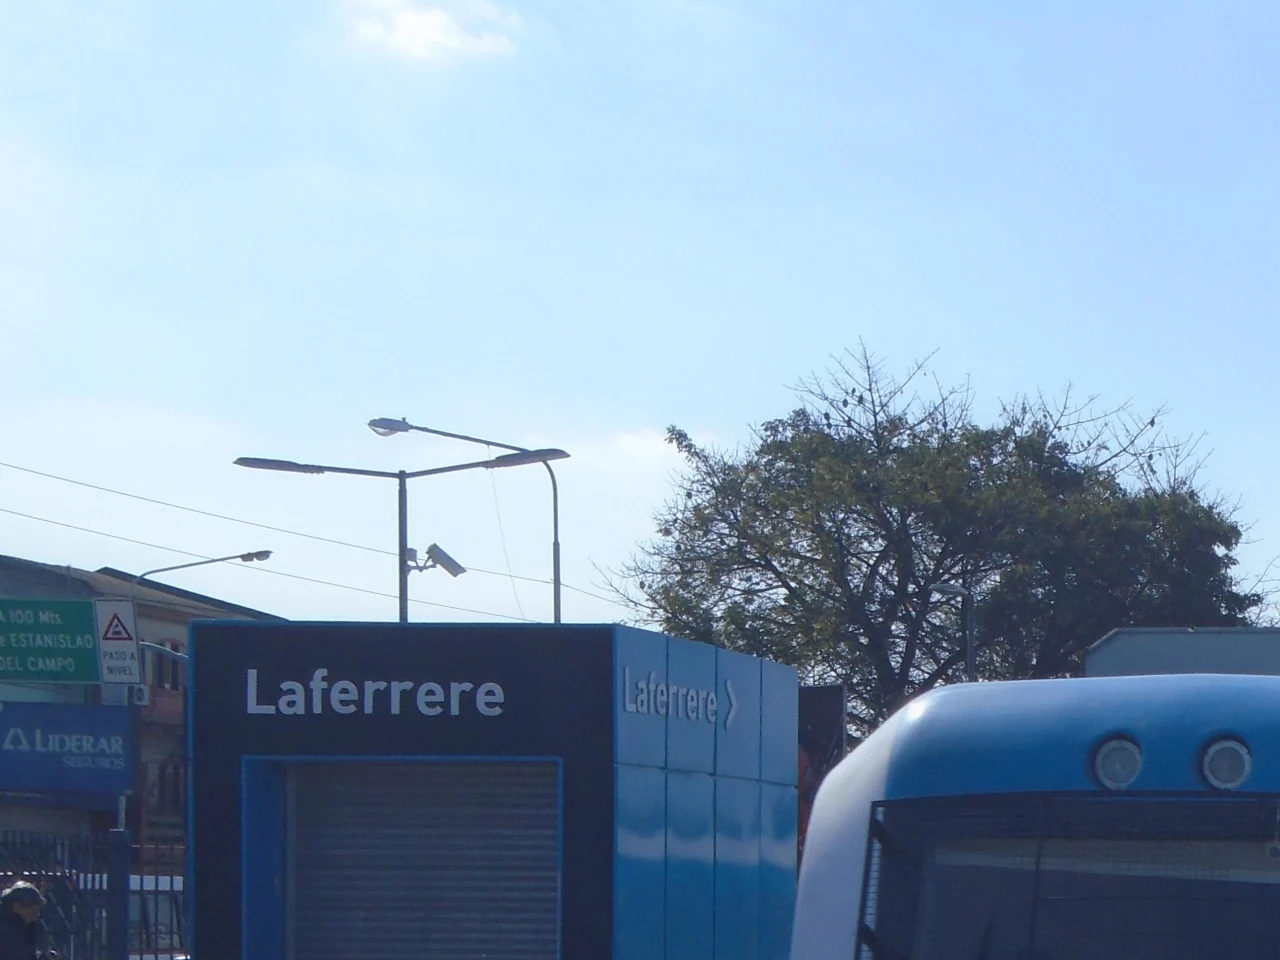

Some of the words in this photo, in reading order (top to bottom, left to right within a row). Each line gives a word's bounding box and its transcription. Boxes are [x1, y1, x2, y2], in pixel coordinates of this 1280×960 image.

[9, 610, 34, 625] 100
[10, 633, 94, 649] ESTANISLAO
[0, 656, 23, 671] DEL
[27, 656, 75, 672] CAMPO
[103, 651, 127, 661] PASO
[128, 651, 136, 661] A
[107, 665, 133, 677] NIVEL
[246, 668, 505, 717] Laferrere
[623, 666, 717, 725] Laferrere
[35, 728, 124, 755] LIDERAR
